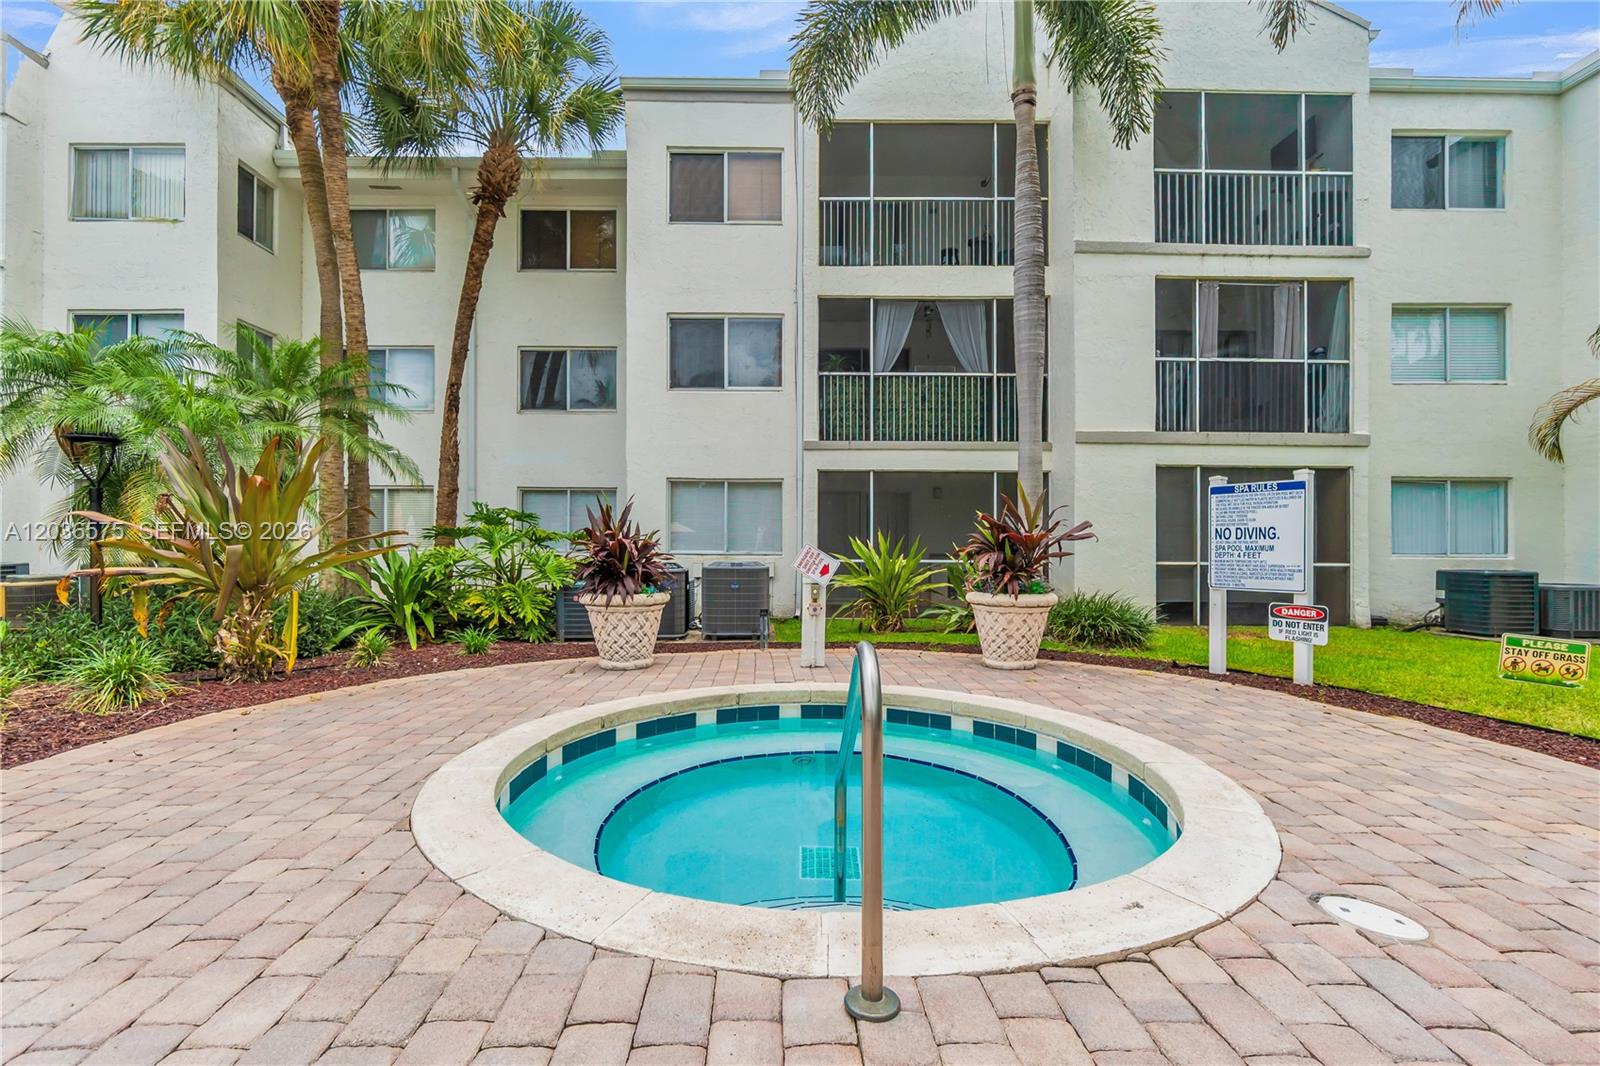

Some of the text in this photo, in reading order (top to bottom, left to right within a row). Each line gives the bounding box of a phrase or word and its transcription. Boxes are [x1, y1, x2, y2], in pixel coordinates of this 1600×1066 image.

[1234, 483, 1278, 494] SPA RULES
[1215, 527, 1280, 540] NO DIVING.
[1281, 608, 1317, 618] DANGER
[1285, 621, 1301, 629] NOT
[1302, 622, 1325, 632] ENTER
[1522, 640, 1569, 651] PLEASE
[1504, 647, 1586, 664] STAY OFF GRASS
